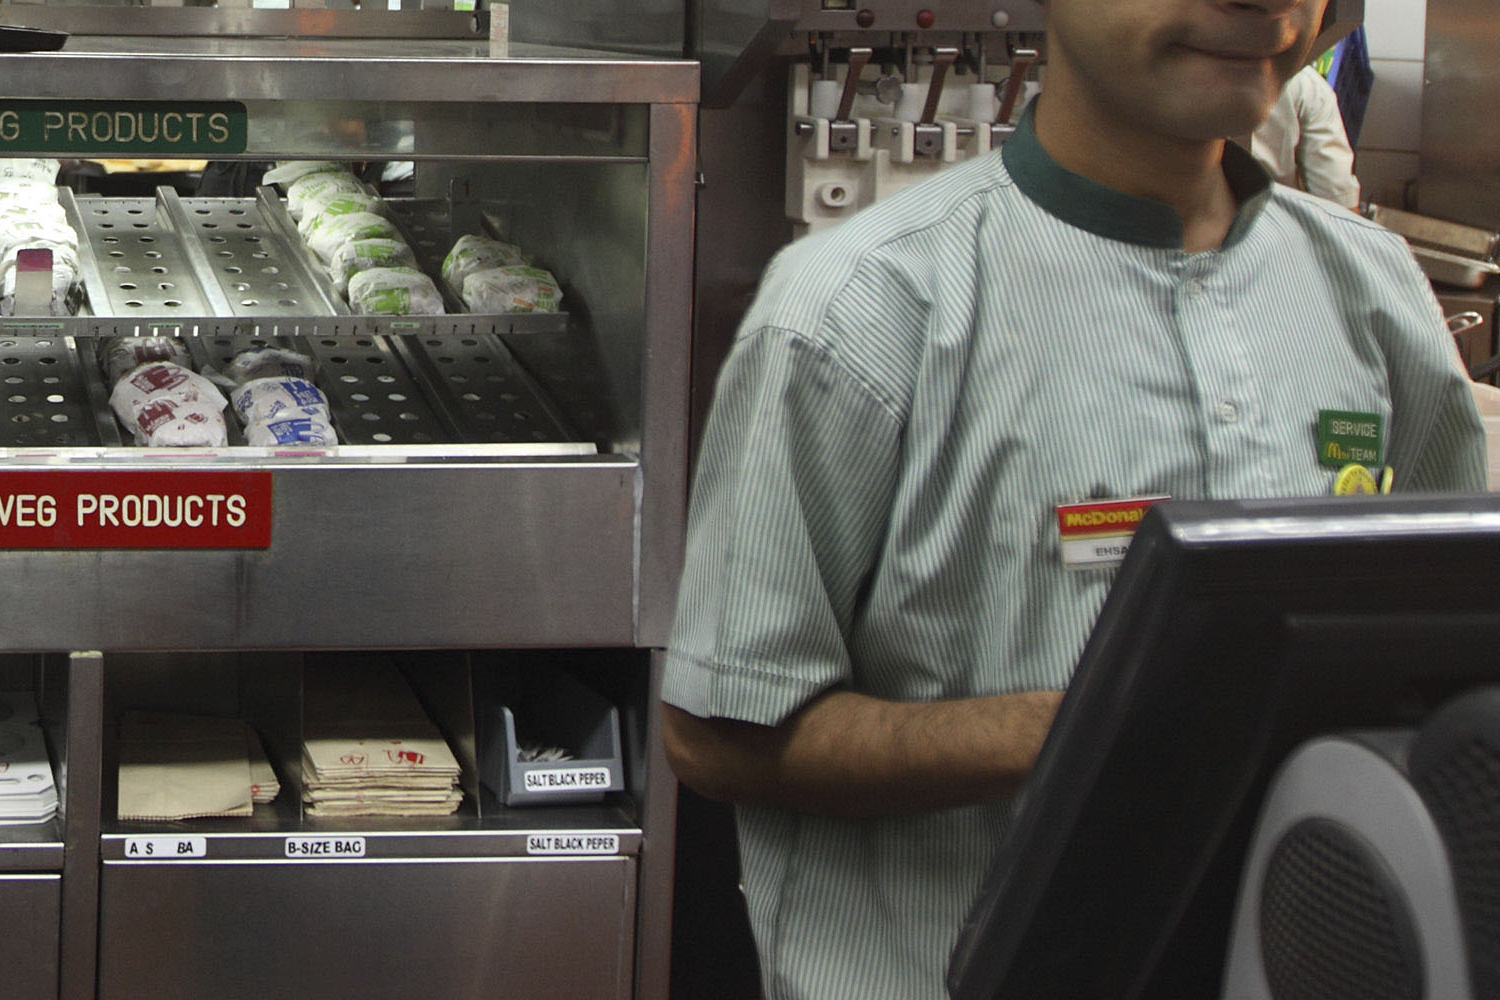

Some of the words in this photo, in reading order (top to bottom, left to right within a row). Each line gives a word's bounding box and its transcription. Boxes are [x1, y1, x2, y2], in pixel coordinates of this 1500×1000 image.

[44, 111, 230, 143] PRODUCTS
[1331, 420, 1378, 438] SERVICE
[1348, 448, 1378, 461] TEAM
[77, 494, 247, 527] PRODUCTS
[526, 773, 547, 787] SALT
[547, 772, 577, 787] BLACK
[578, 772, 607, 787] PEPER
[287, 840, 331, 854] B-SIZE
[529, 837, 551, 851] SALT
[553, 837, 583, 851] BLACK
[584, 836, 615, 850] PEPER
